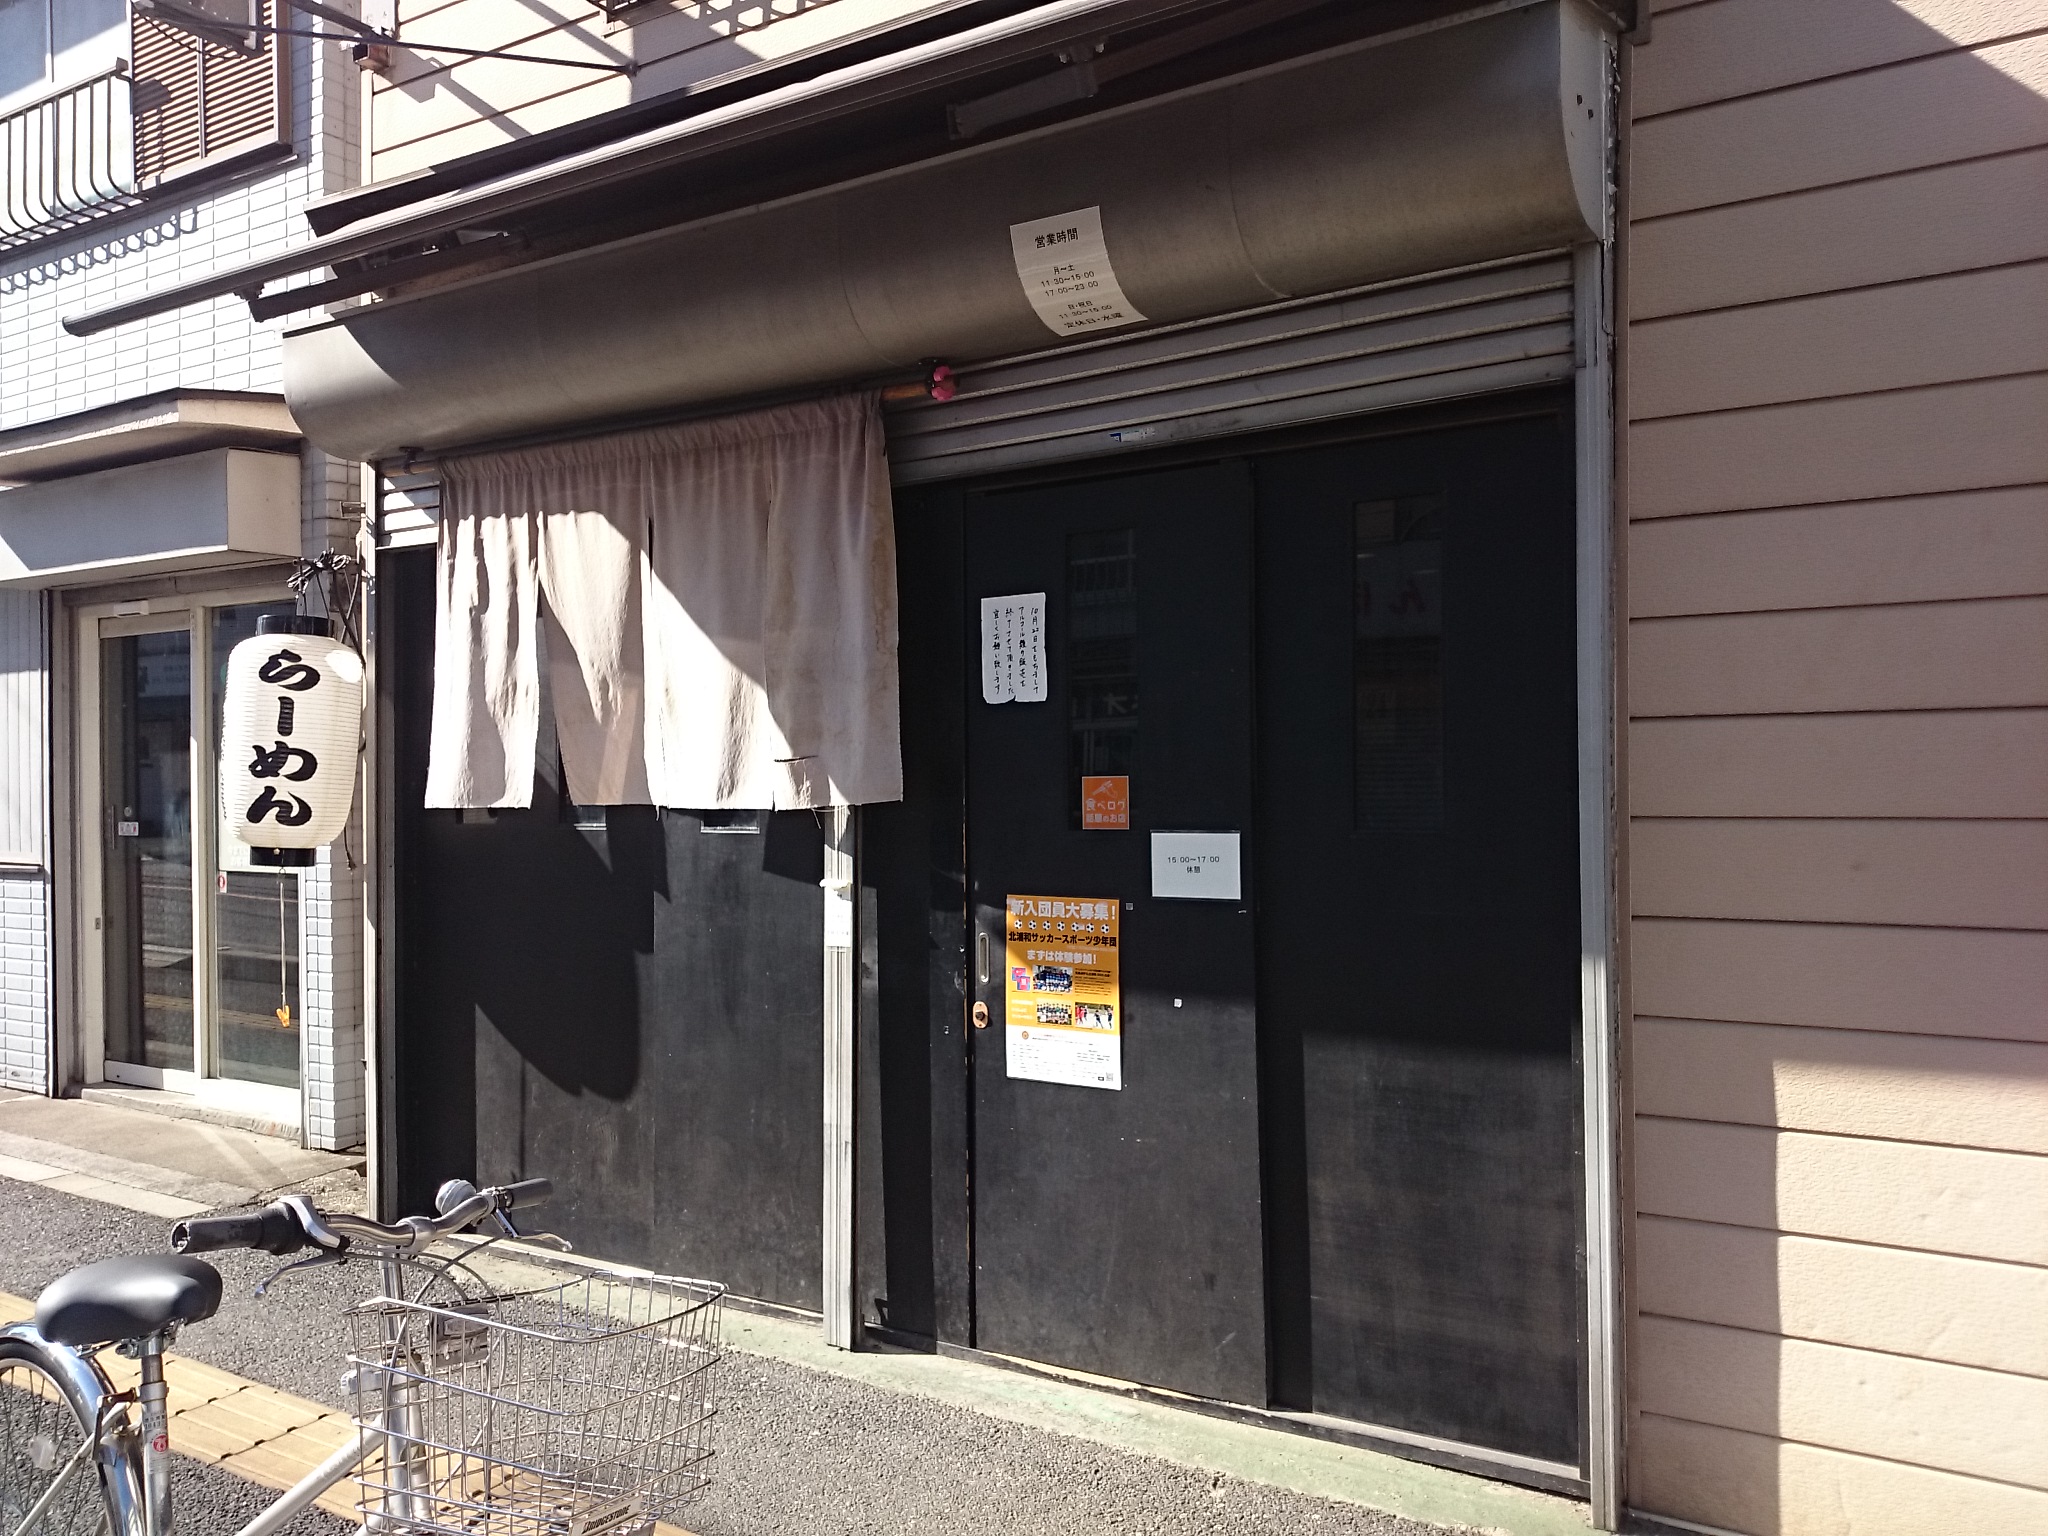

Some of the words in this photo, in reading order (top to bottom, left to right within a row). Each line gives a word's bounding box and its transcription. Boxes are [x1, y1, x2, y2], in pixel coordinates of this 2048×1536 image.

[1034, 227, 1079, 249] 営業時間
[246, 649, 321, 826] らーめん
[1085, 798, 1126, 812] 食べログ
[1008, 931, 1117, 947] 北浦和サッカースポーツ少年団
